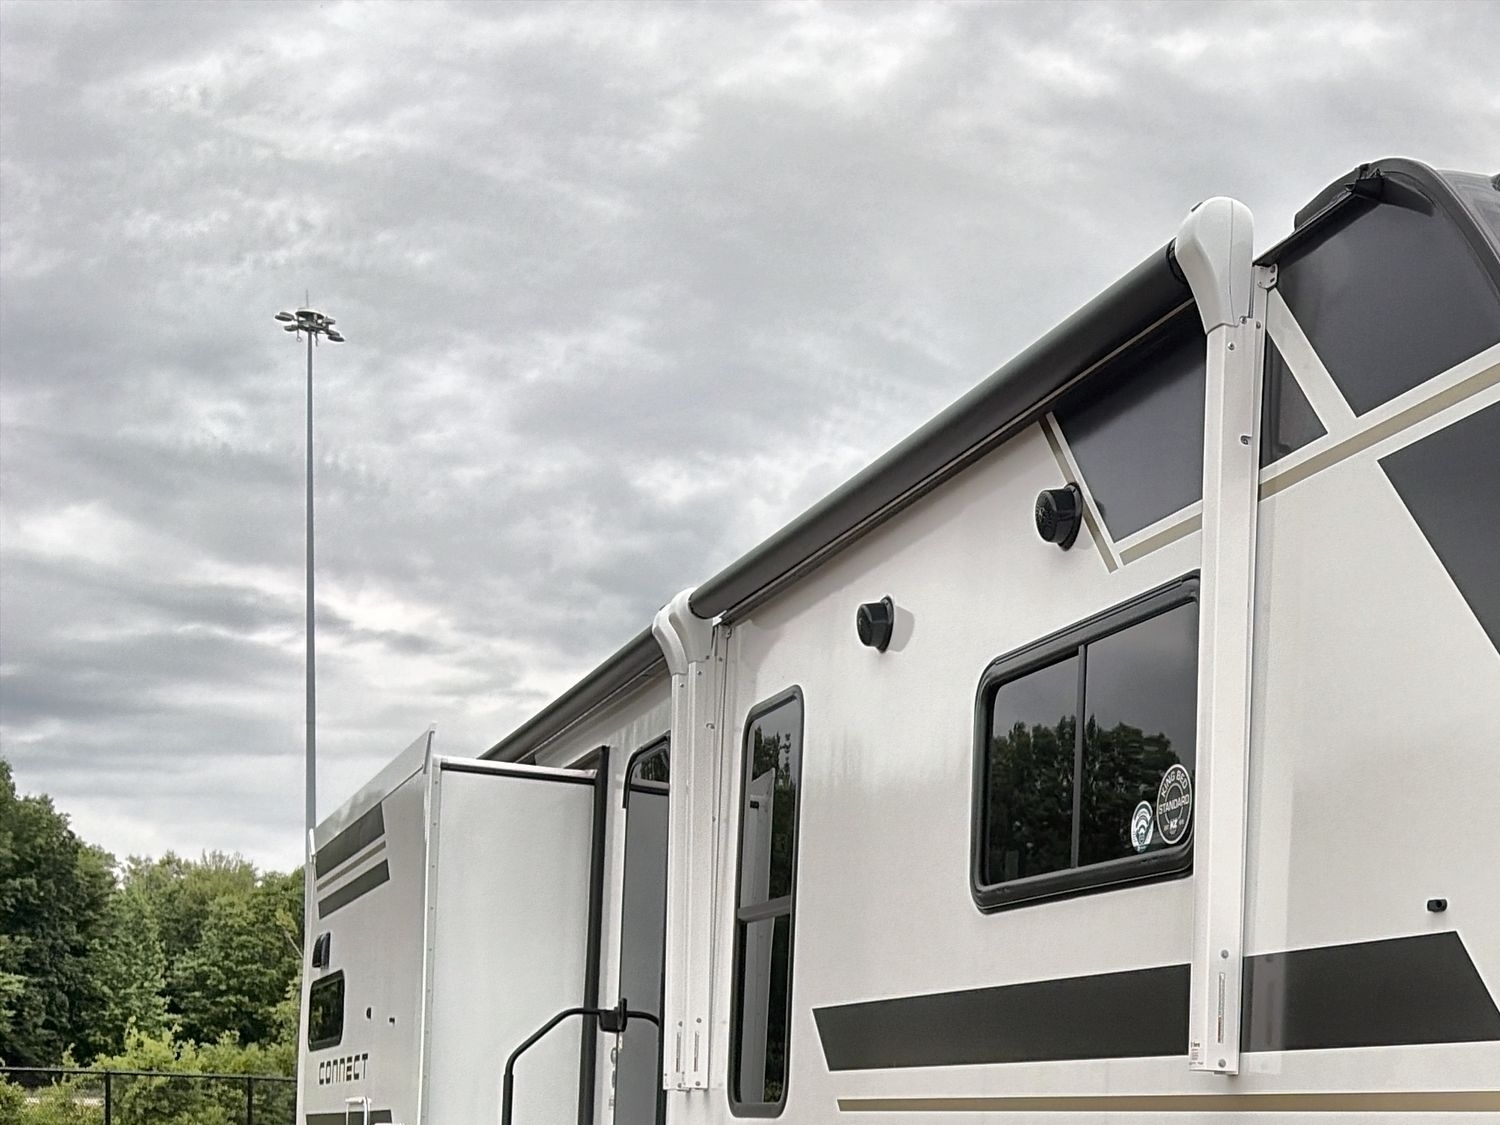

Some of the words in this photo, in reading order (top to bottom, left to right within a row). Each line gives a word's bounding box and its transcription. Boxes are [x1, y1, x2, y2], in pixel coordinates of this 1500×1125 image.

[1161, 770, 1176, 797] KING
[1176, 769, 1188, 790] BED
[1158, 793, 1190, 815] STANDARD
